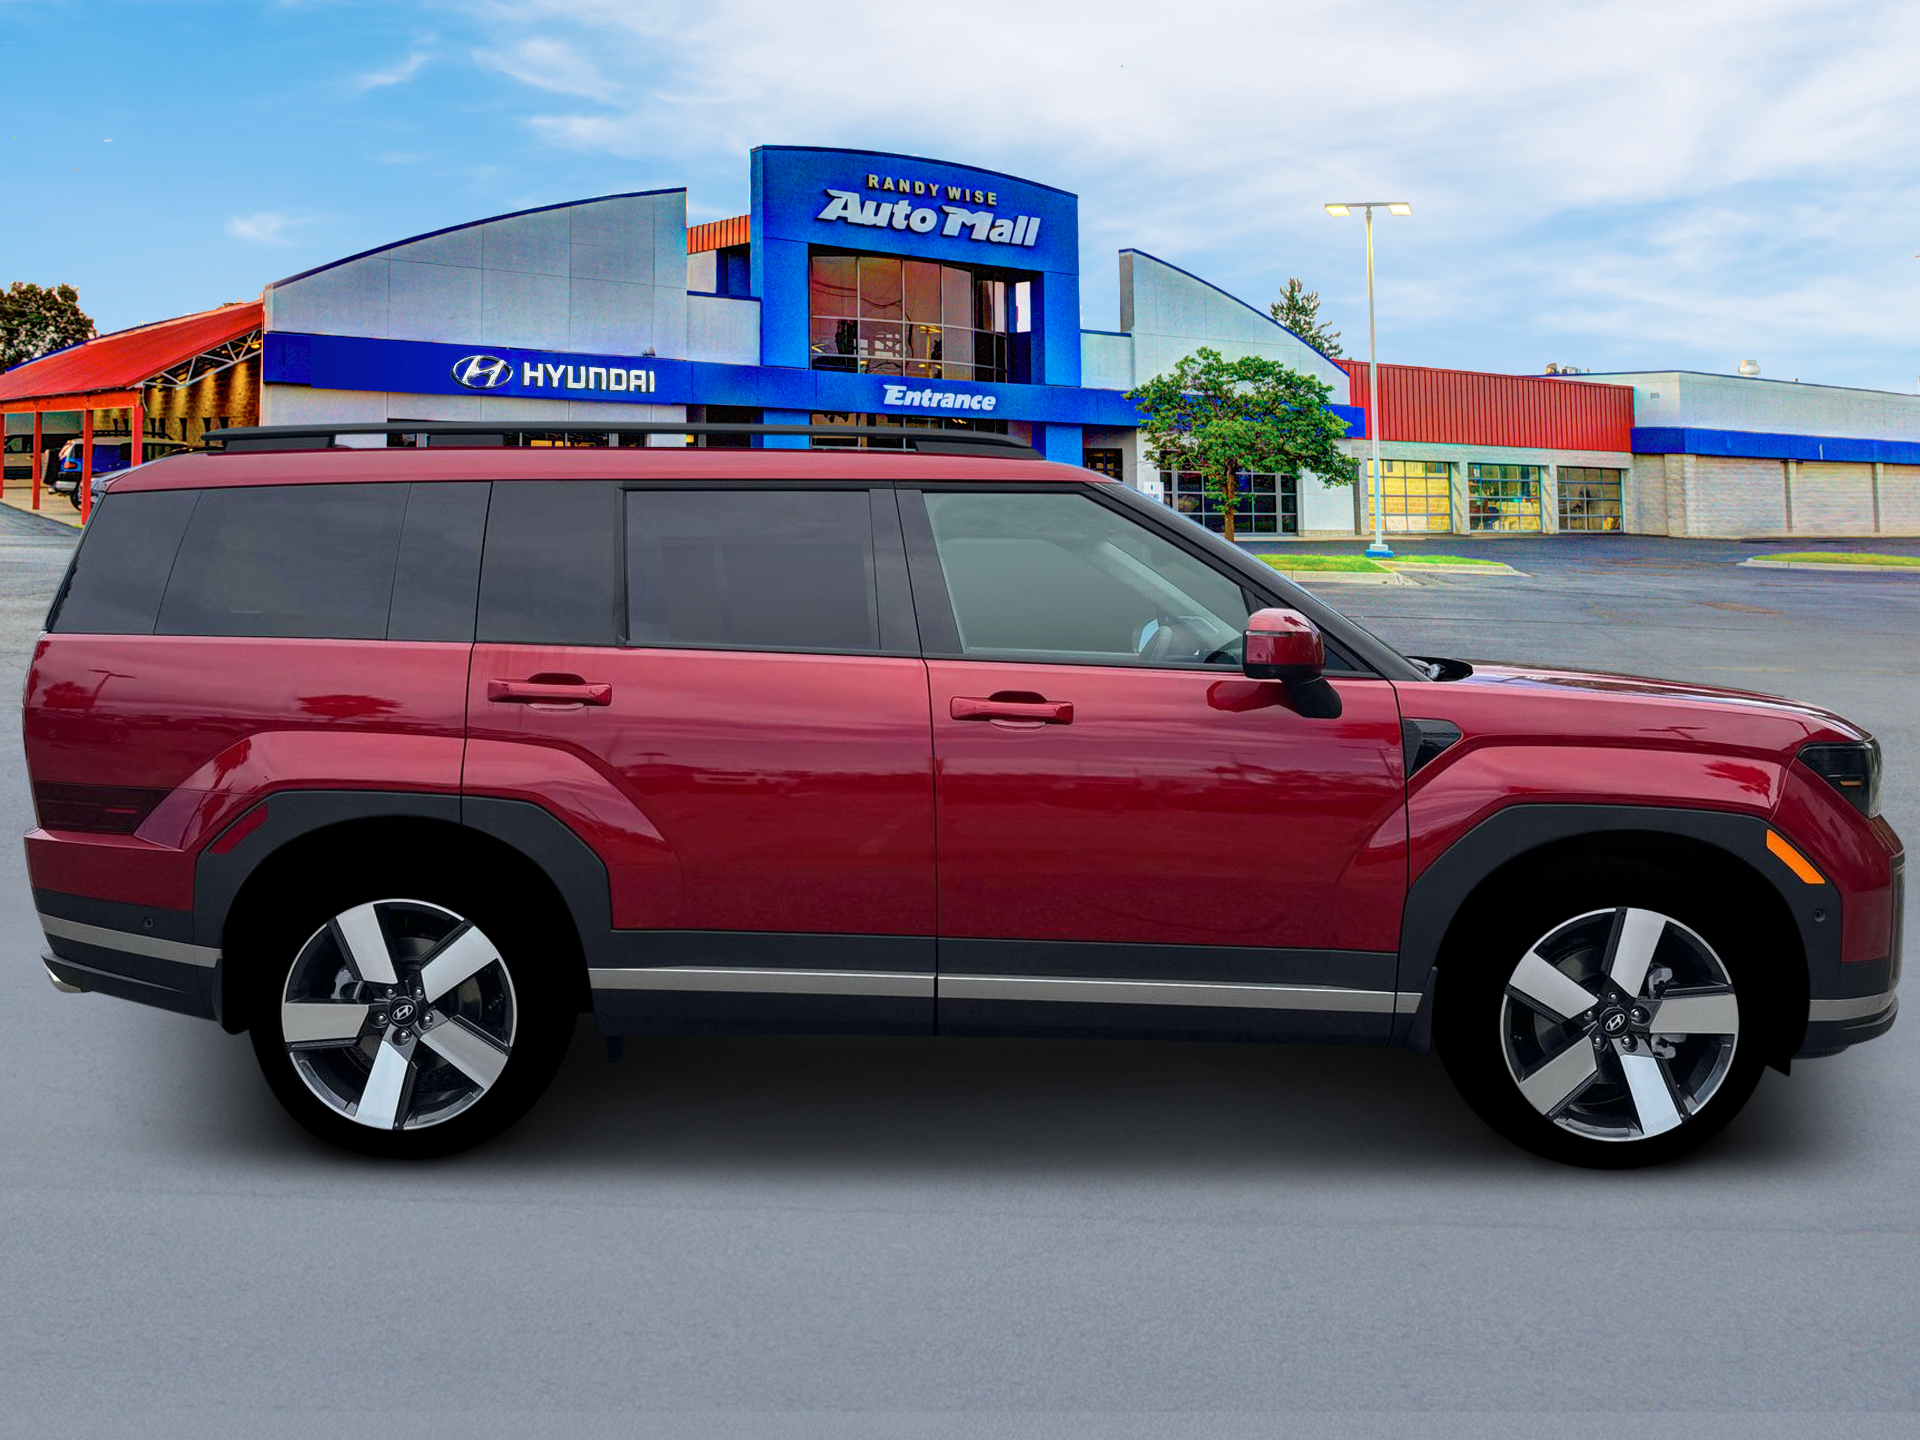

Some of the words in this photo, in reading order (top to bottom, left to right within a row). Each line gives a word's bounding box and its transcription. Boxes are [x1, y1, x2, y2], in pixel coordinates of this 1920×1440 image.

[867, 174, 939, 196] RANDY
[946, 186, 997, 205] WISE
[817, 189, 937, 233] Auto
[941, 205, 1040, 246] Mall
[522, 362, 655, 393] HYUNDAI
[883, 384, 996, 411] Entrance
